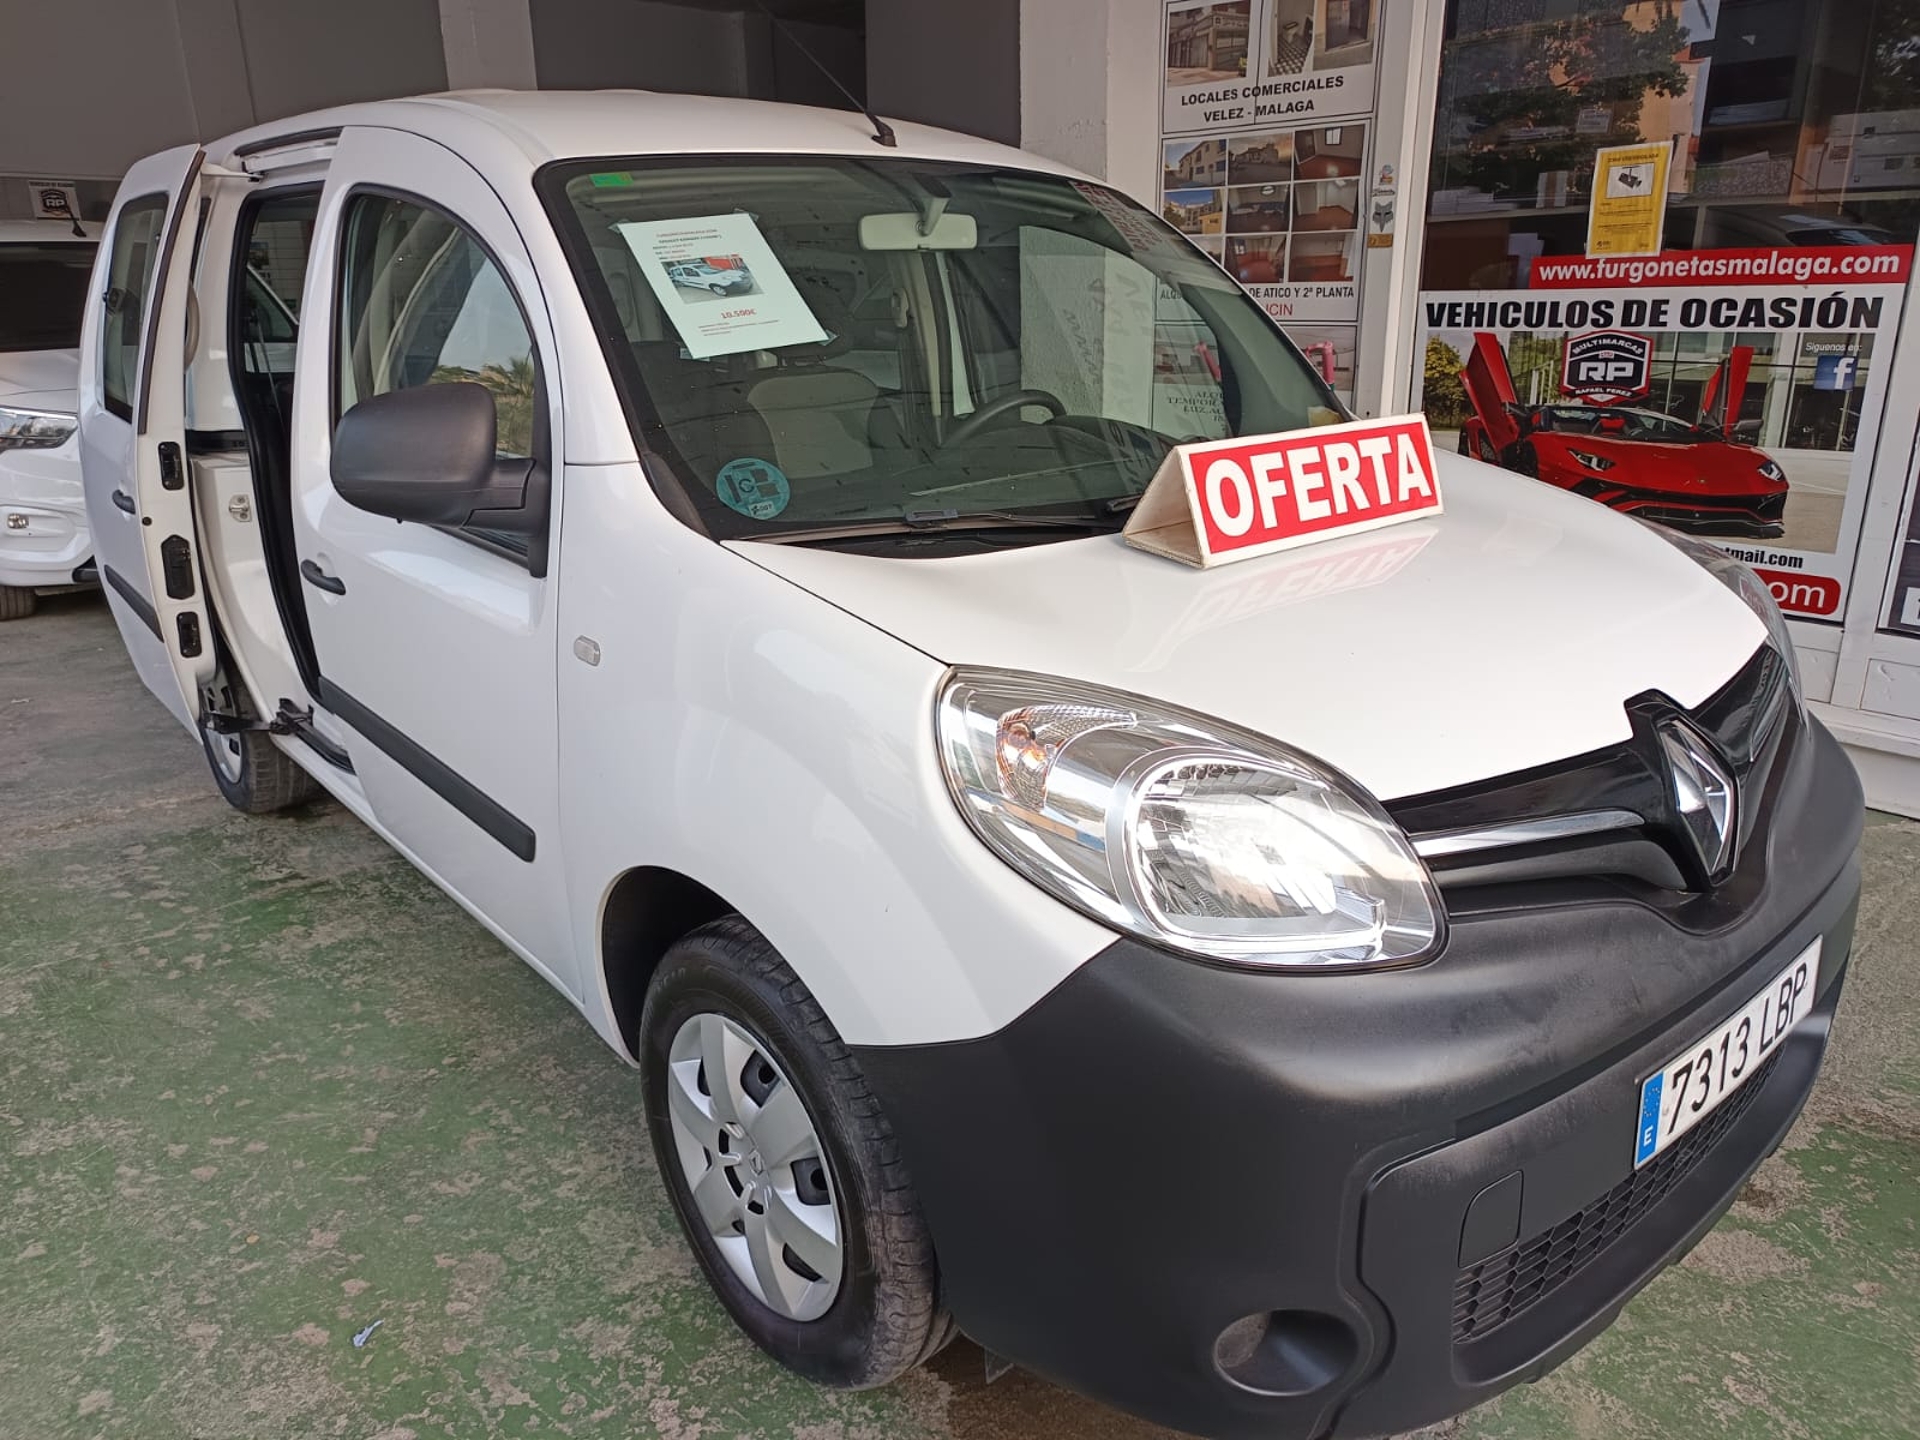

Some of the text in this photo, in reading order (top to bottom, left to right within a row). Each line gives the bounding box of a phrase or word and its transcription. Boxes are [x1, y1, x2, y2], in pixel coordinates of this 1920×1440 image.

[1181, 75, 1344, 106] LOCALES COMERCIALES
[1204, 107, 1244, 122] VELEZ
[1255, 100, 1315, 117] MALAGA
[46, 199, 65, 207] RP
[1539, 250, 1899, 283] www.furgonetasmalaga.com
[1263, 287, 1291, 298] ATICO
[1294, 287, 1301, 298] Y
[1315, 286, 1354, 298] PLANTA
[1426, 290, 1884, 329] VEHICULOS DE OCASIÓN
[1572, 338, 1644, 355] MULTIMARCAS
[1579, 362, 1634, 381] RP
[1205, 433, 1432, 537] OFERTA
[1668, 962, 1807, 1135] 7313 LBP
[1643, 1125, 1653, 1146] E
